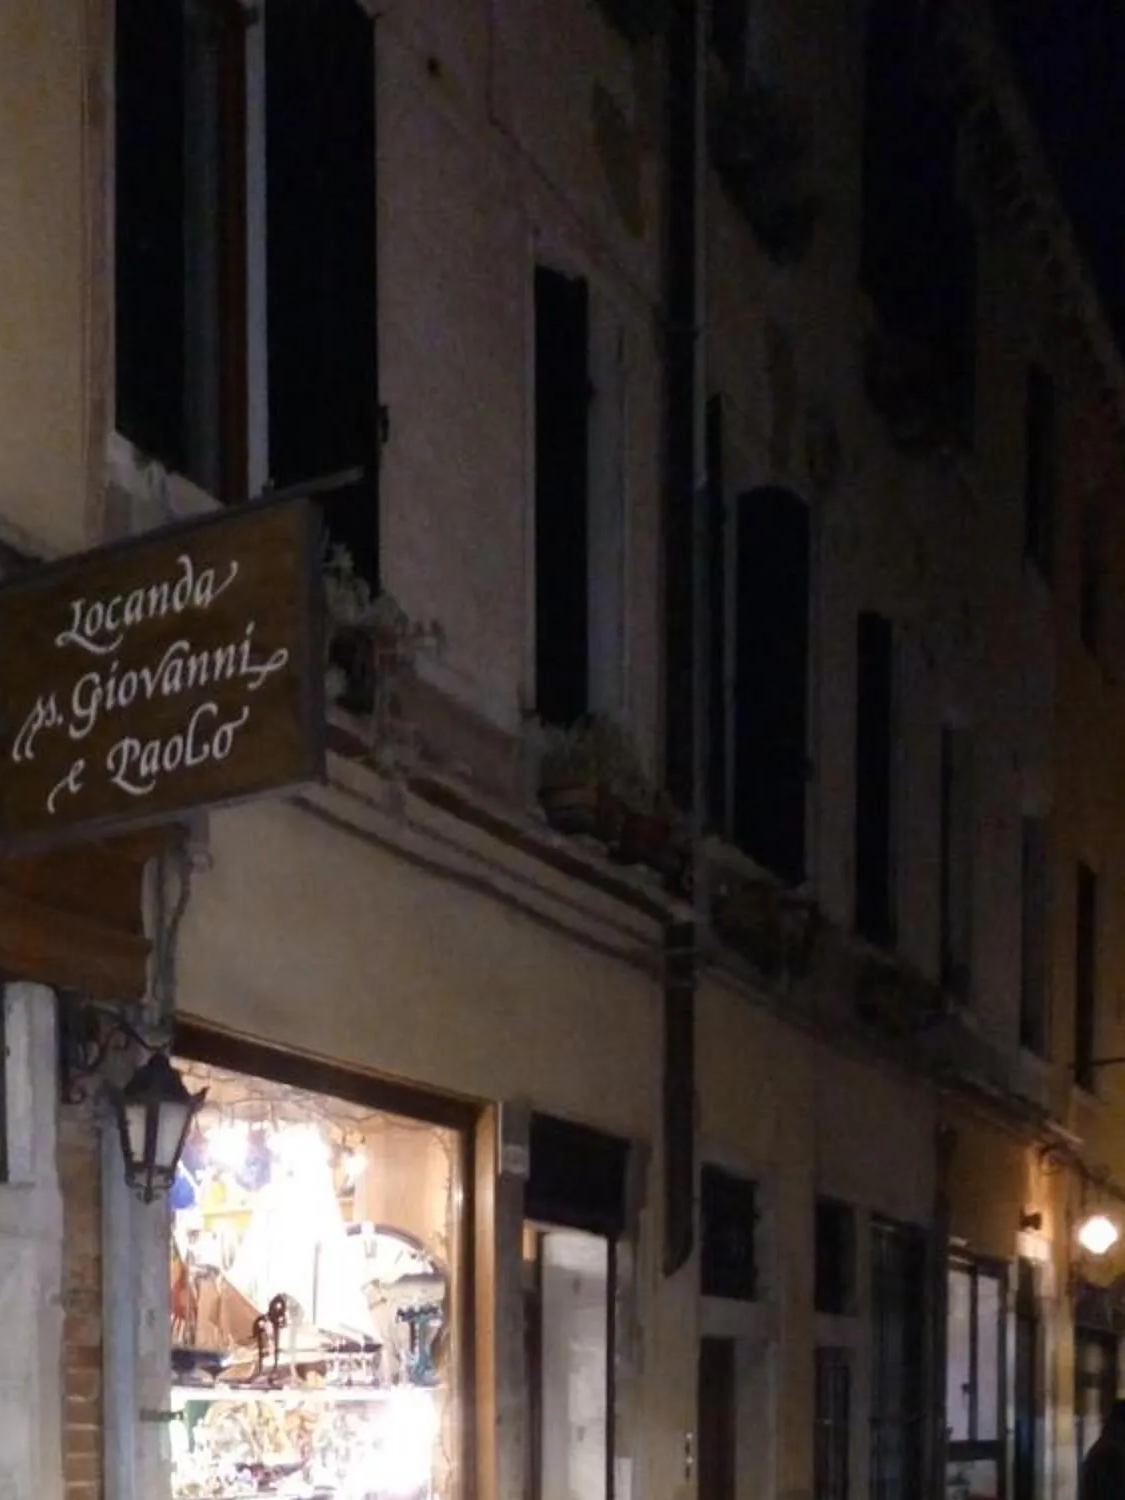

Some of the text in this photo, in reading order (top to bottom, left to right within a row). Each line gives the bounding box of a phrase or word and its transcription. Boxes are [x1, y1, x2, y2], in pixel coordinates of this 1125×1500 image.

[55, 554, 238, 652] Locanda
[68, 621, 289, 740] Giovanni
[47, 702, 250, 814] e Paolo
